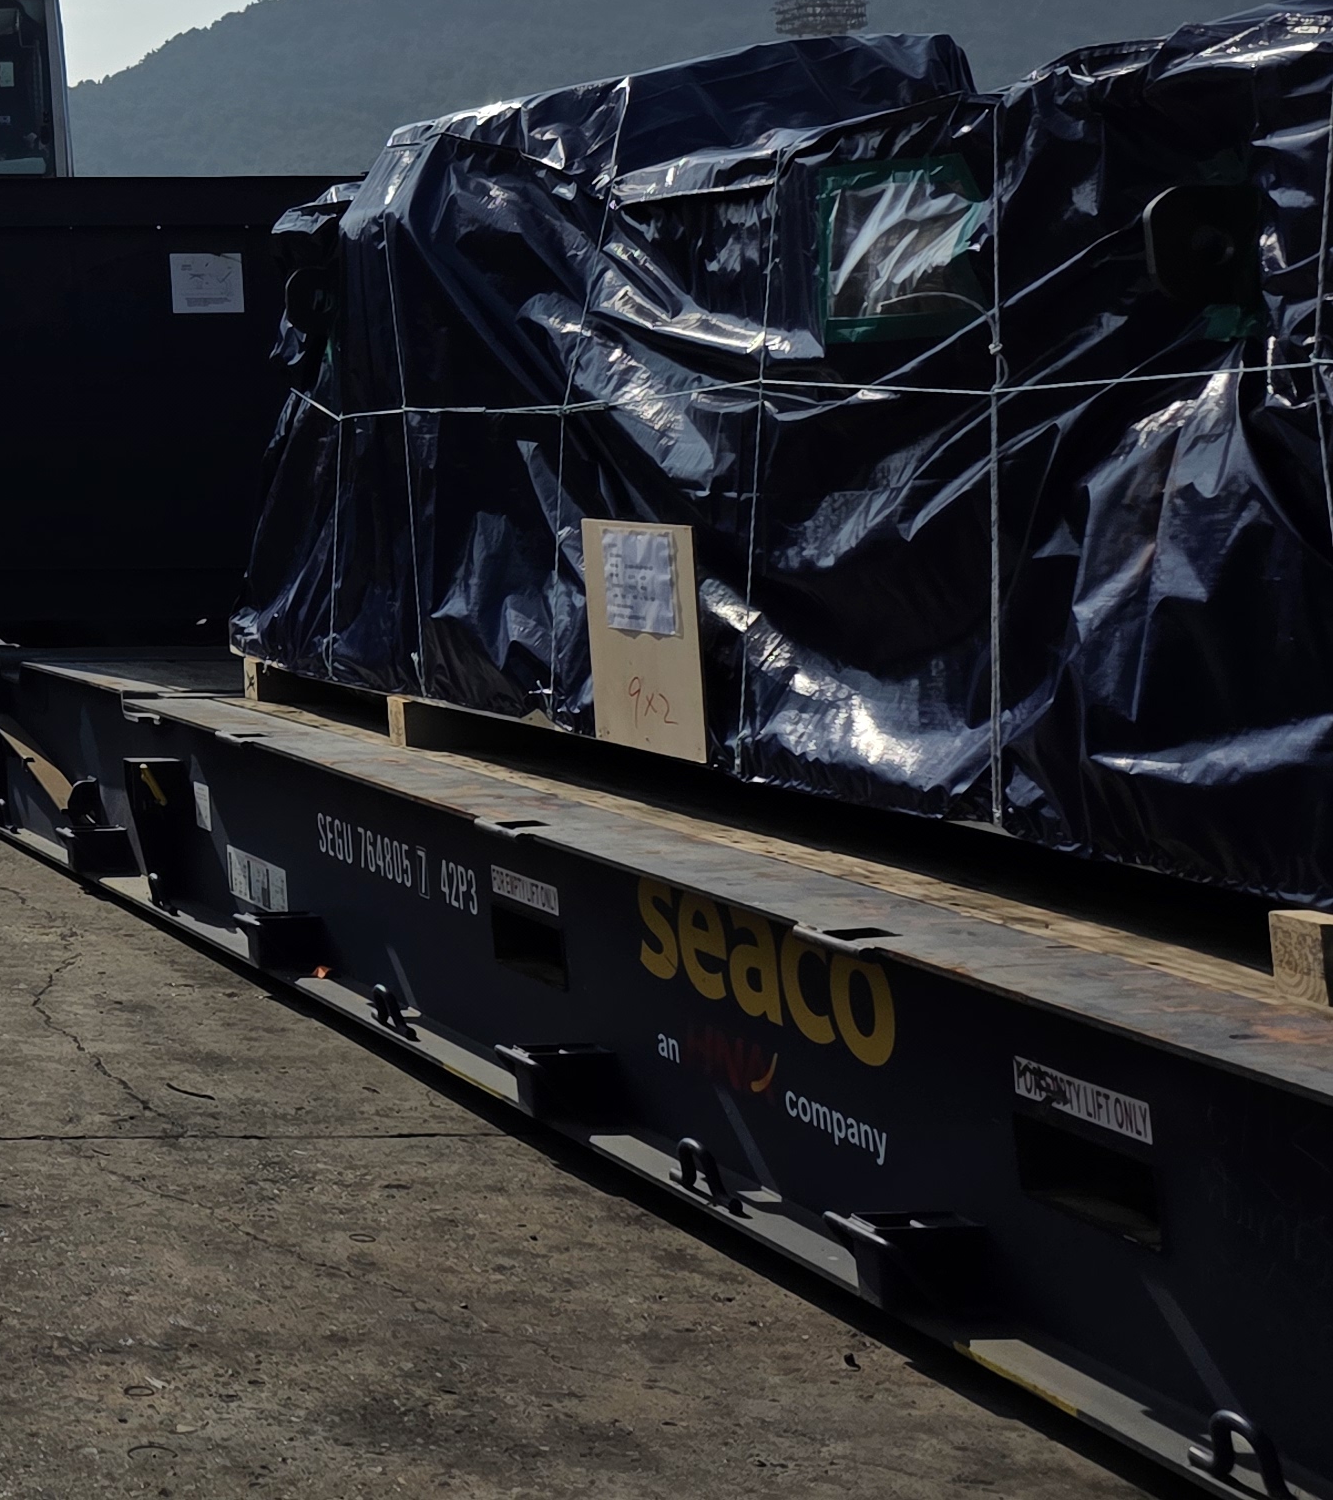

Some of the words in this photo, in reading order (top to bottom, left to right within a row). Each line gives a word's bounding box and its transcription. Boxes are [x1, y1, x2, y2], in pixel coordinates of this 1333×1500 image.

[317, 812, 354, 865] SEGU
[357, 826, 412, 888] 764805
[416, 848, 428, 895] 7
[440, 858, 479, 916] 42P3
[637, 875, 896, 1067] seaco
[656, 1031, 681, 1064] an
[784, 1089, 888, 1167] company
[1082, 1085, 1111, 1125] LIFT
[1113, 1096, 1148, 1140] ONLY
